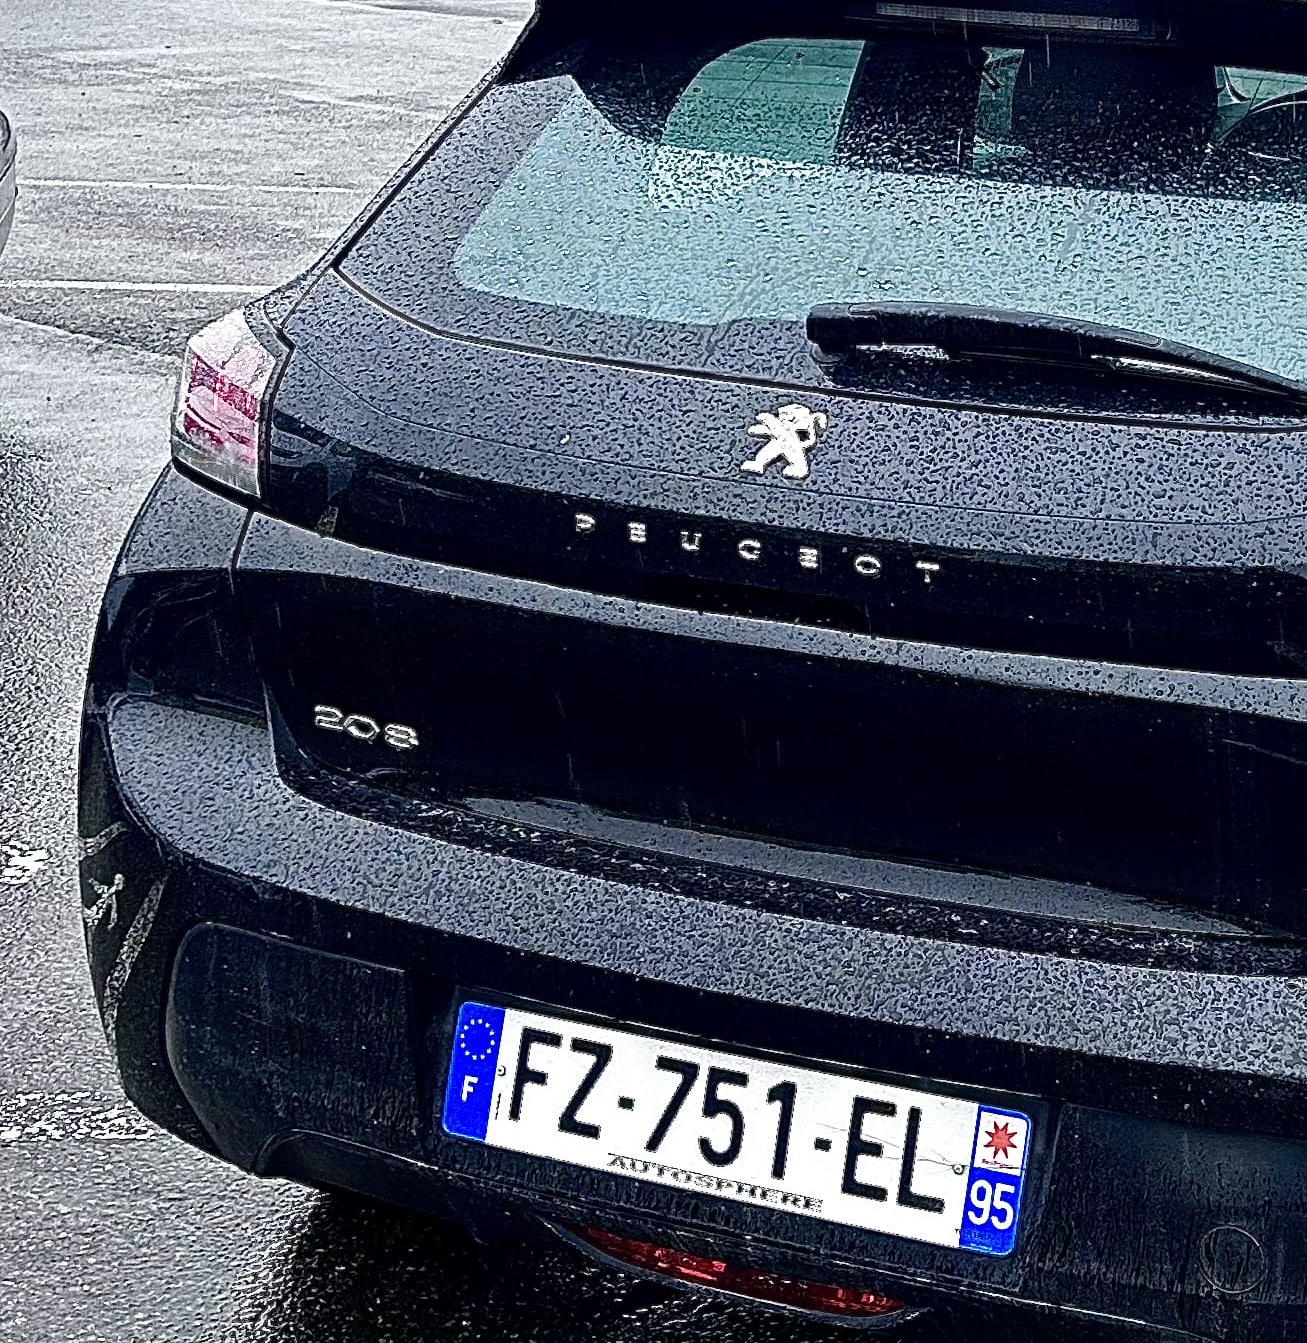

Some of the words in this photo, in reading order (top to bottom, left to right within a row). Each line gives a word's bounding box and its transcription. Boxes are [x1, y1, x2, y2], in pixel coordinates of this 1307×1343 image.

[574, 512, 941, 584] PEUGEOT
[314, 704, 419, 751] 208
[460, 1075, 478, 1102] F
[508, 1024, 946, 1215] FZ-751-EL
[607, 1152, 824, 1214] AUTOSPHERE
[967, 1178, 1014, 1230] 95
